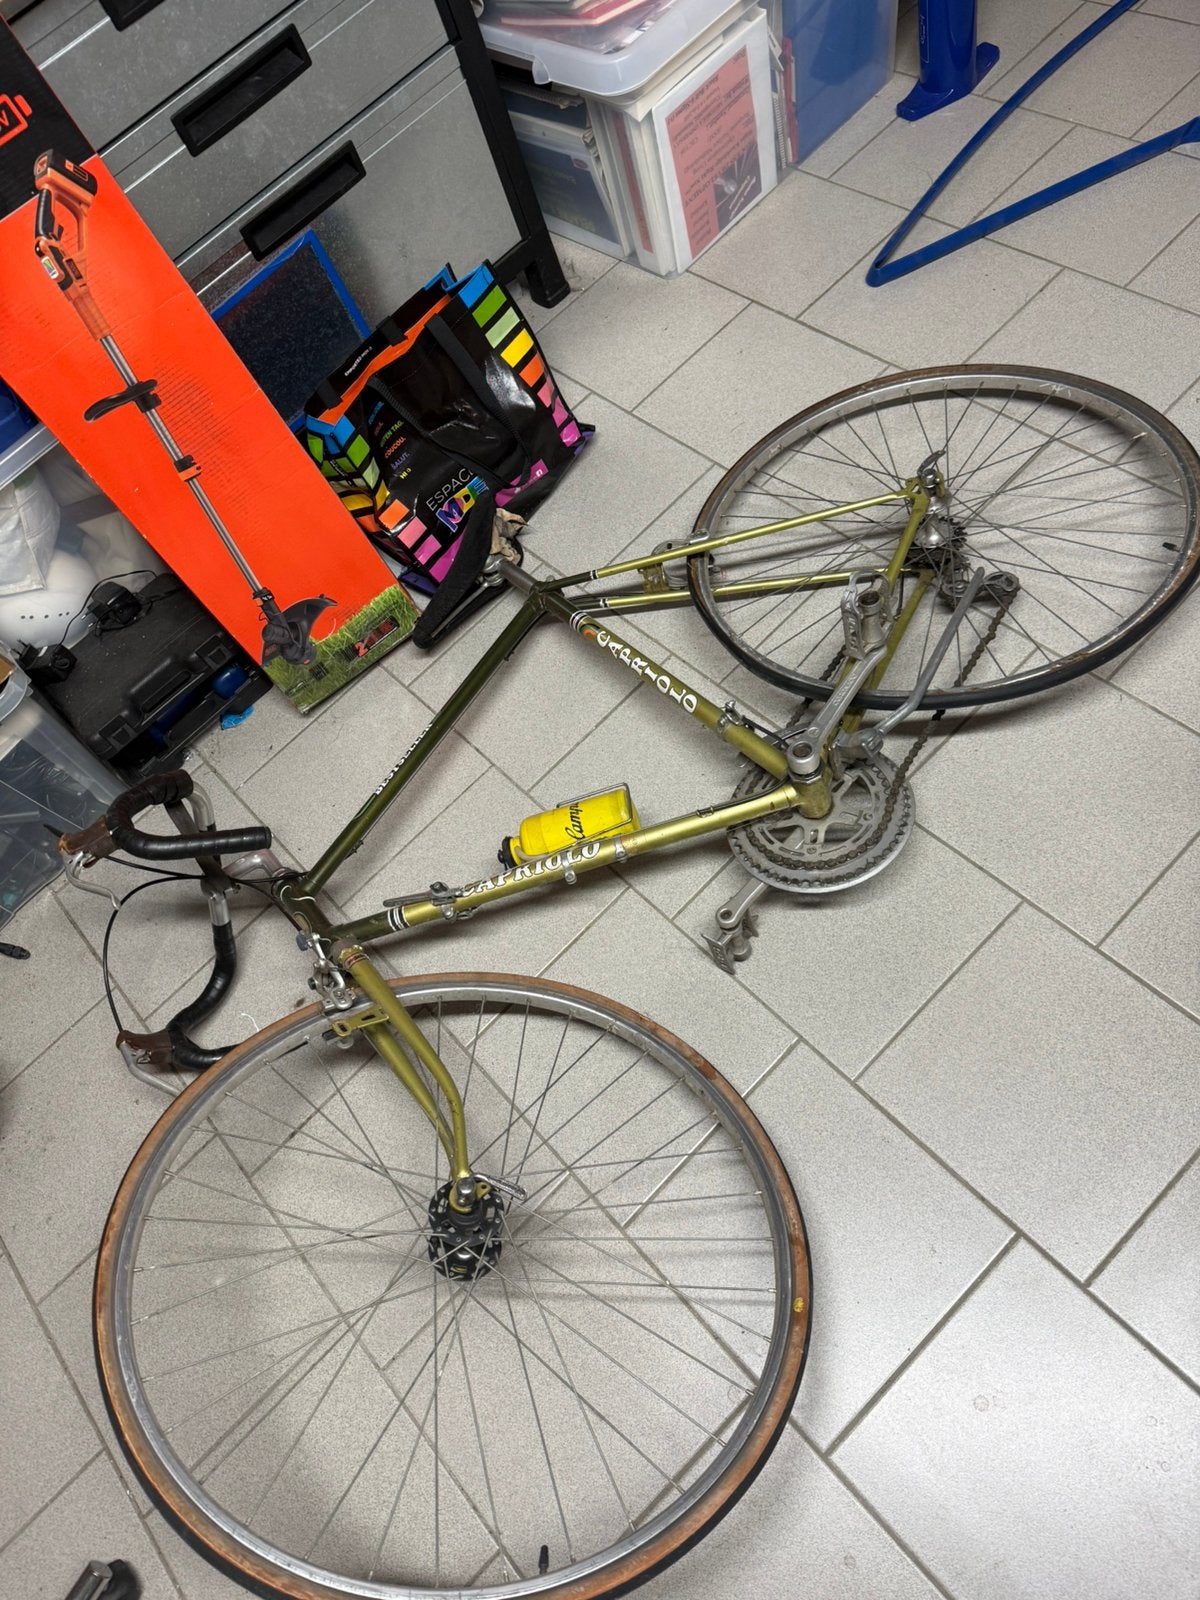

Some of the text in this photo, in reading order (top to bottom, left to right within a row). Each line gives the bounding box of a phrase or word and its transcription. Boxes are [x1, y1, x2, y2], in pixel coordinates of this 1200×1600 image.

[426, 468, 474, 511] ESPAC
[596, 630, 698, 713] CAPRIOLO
[564, 801, 585, 840] Camp
[460, 841, 601, 897] CAPRIOLO
